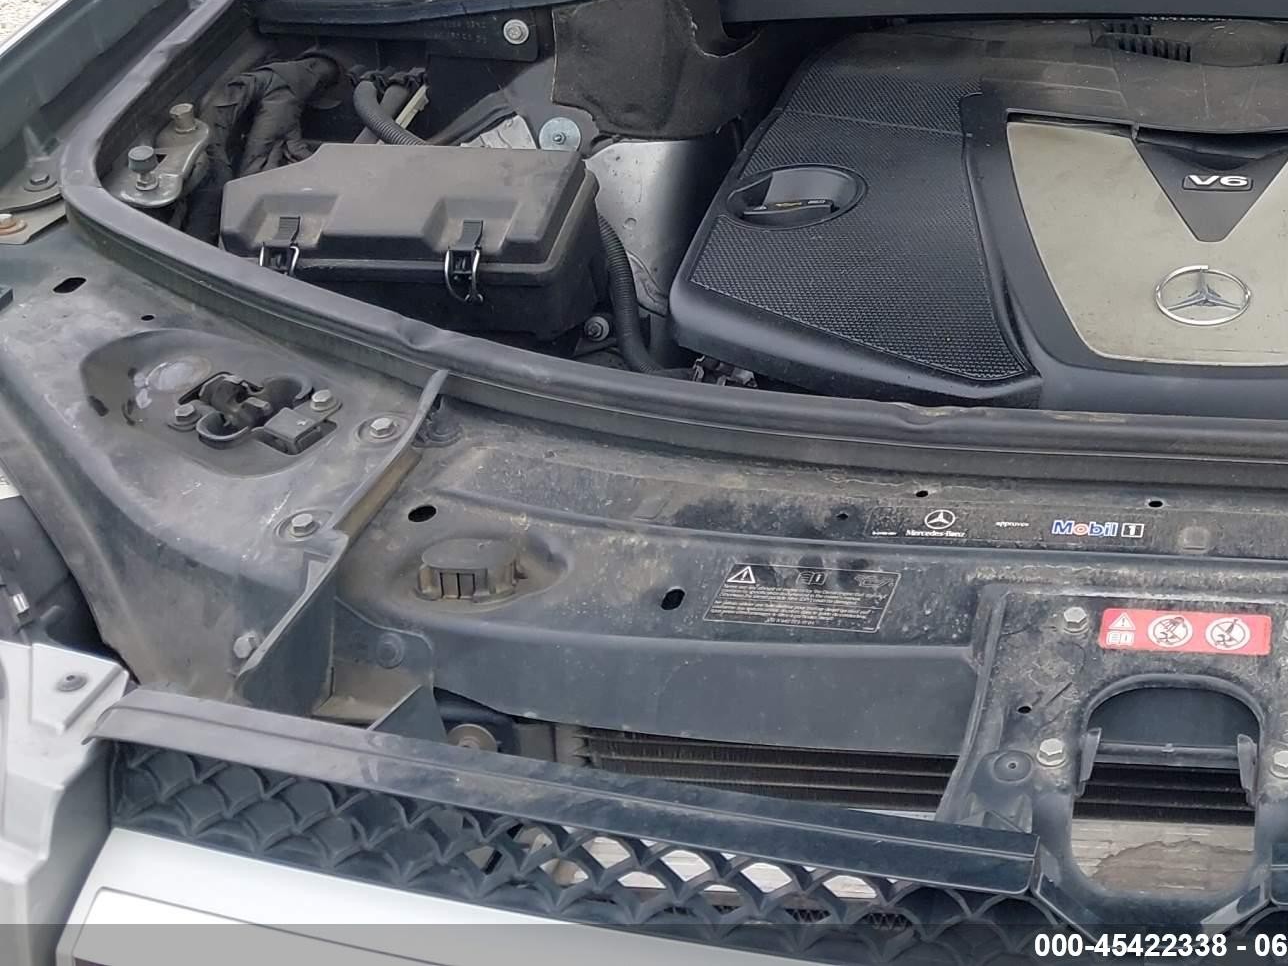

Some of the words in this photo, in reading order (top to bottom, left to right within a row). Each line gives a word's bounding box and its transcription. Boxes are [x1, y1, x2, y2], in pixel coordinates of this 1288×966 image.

[1188, 175, 1248, 187] V6
[905, 529, 965, 537] Mercedes-Benz
[1051, 520, 1119, 536] Mobil
